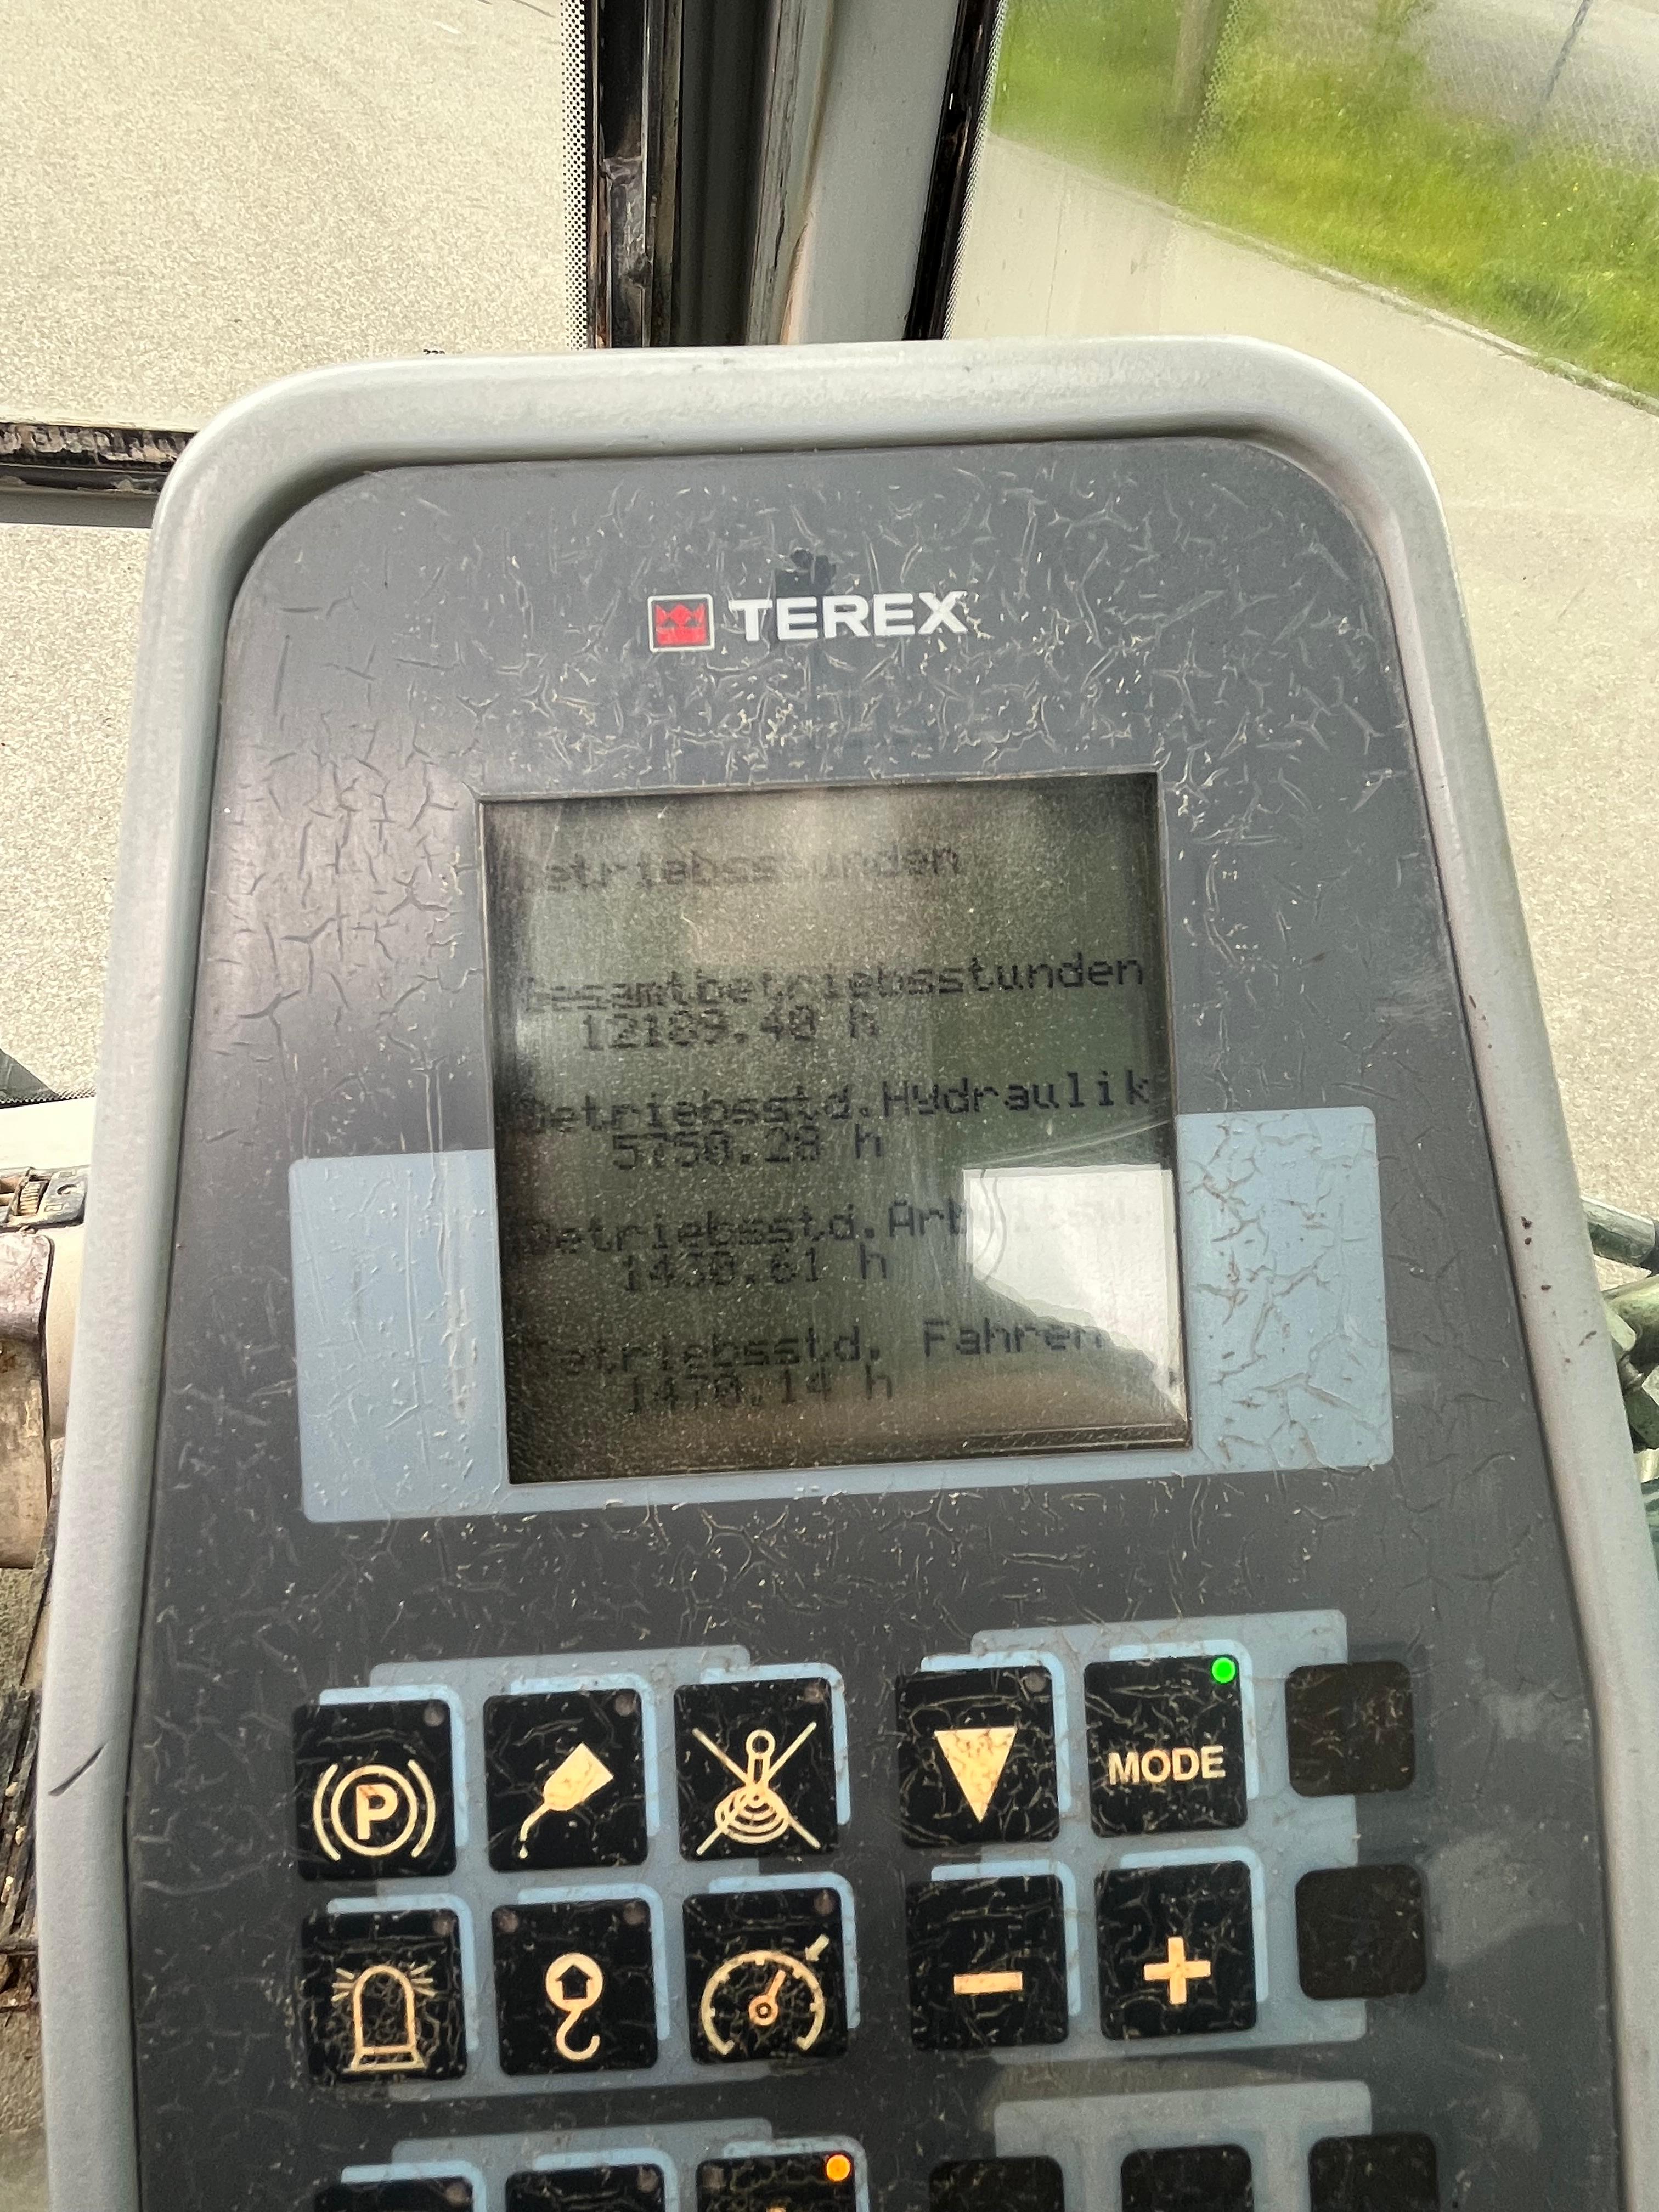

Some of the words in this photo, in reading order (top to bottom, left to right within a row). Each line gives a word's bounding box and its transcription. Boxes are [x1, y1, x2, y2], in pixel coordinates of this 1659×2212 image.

[728, 590, 967, 642] TEREX
[521, 842, 961, 893] etriebssunden
[848, 1004, 879, 1040] h
[854, 1123, 884, 1159] h
[859, 1245, 888, 1280] h
[531, 1324, 881, 1375] etriebsstd.
[922, 1318, 1104, 1358] Fahren
[865, 1363, 894, 1401] h
[1108, 1745, 1226, 1786] MODE
